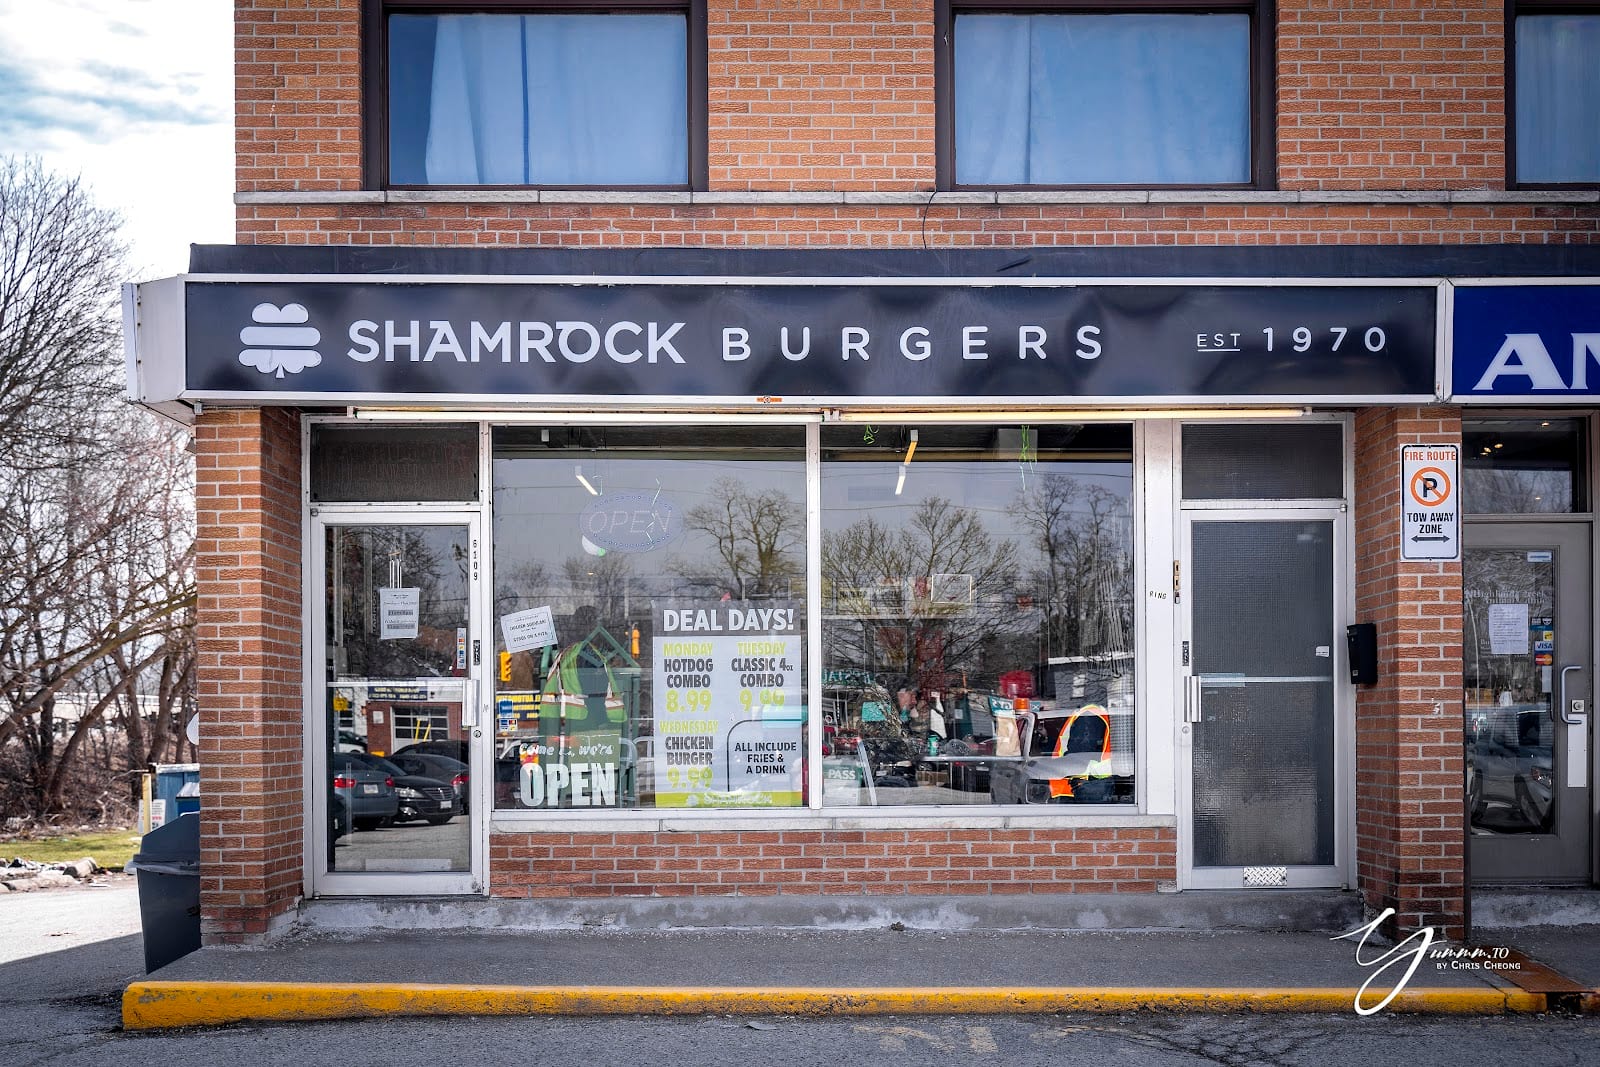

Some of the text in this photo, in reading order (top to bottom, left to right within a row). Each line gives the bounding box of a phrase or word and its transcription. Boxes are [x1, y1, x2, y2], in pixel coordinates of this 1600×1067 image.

[347, 319, 1386, 364] SHAMROCK BURGERS EST 1970
[1404, 451, 1456, 461] FIRE ROUTE
[588, 510, 672, 535] OPEN
[1407, 512, 1454, 523] TOW AWAY
[1419, 524, 1443, 534] ZONE
[1149, 590, 1167, 600] RING
[663, 608, 794, 631] DEAL DAYS!
[663, 642, 714, 657] MONDAY
[736, 641, 787, 655] TUESDAY
[664, 658, 714, 672] HOTDOG
[731, 657, 776, 672] CLASSIC
[666, 674, 711, 688] COMBO
[740, 673, 784, 688] COMBO
[666, 689, 713, 713] 8.99
[660, 720, 719, 734] WEDNESDAY
[665, 736, 714, 750] CHICKEN
[735, 742, 797, 752] ALL INCLUDE
[666, 752, 713, 765] BURGER
[747, 754, 784, 763] FRIES &
[746, 765, 786, 774] A DRINK
[828, 768, 857, 780] PASS
[520, 762, 616, 807] OPEN
